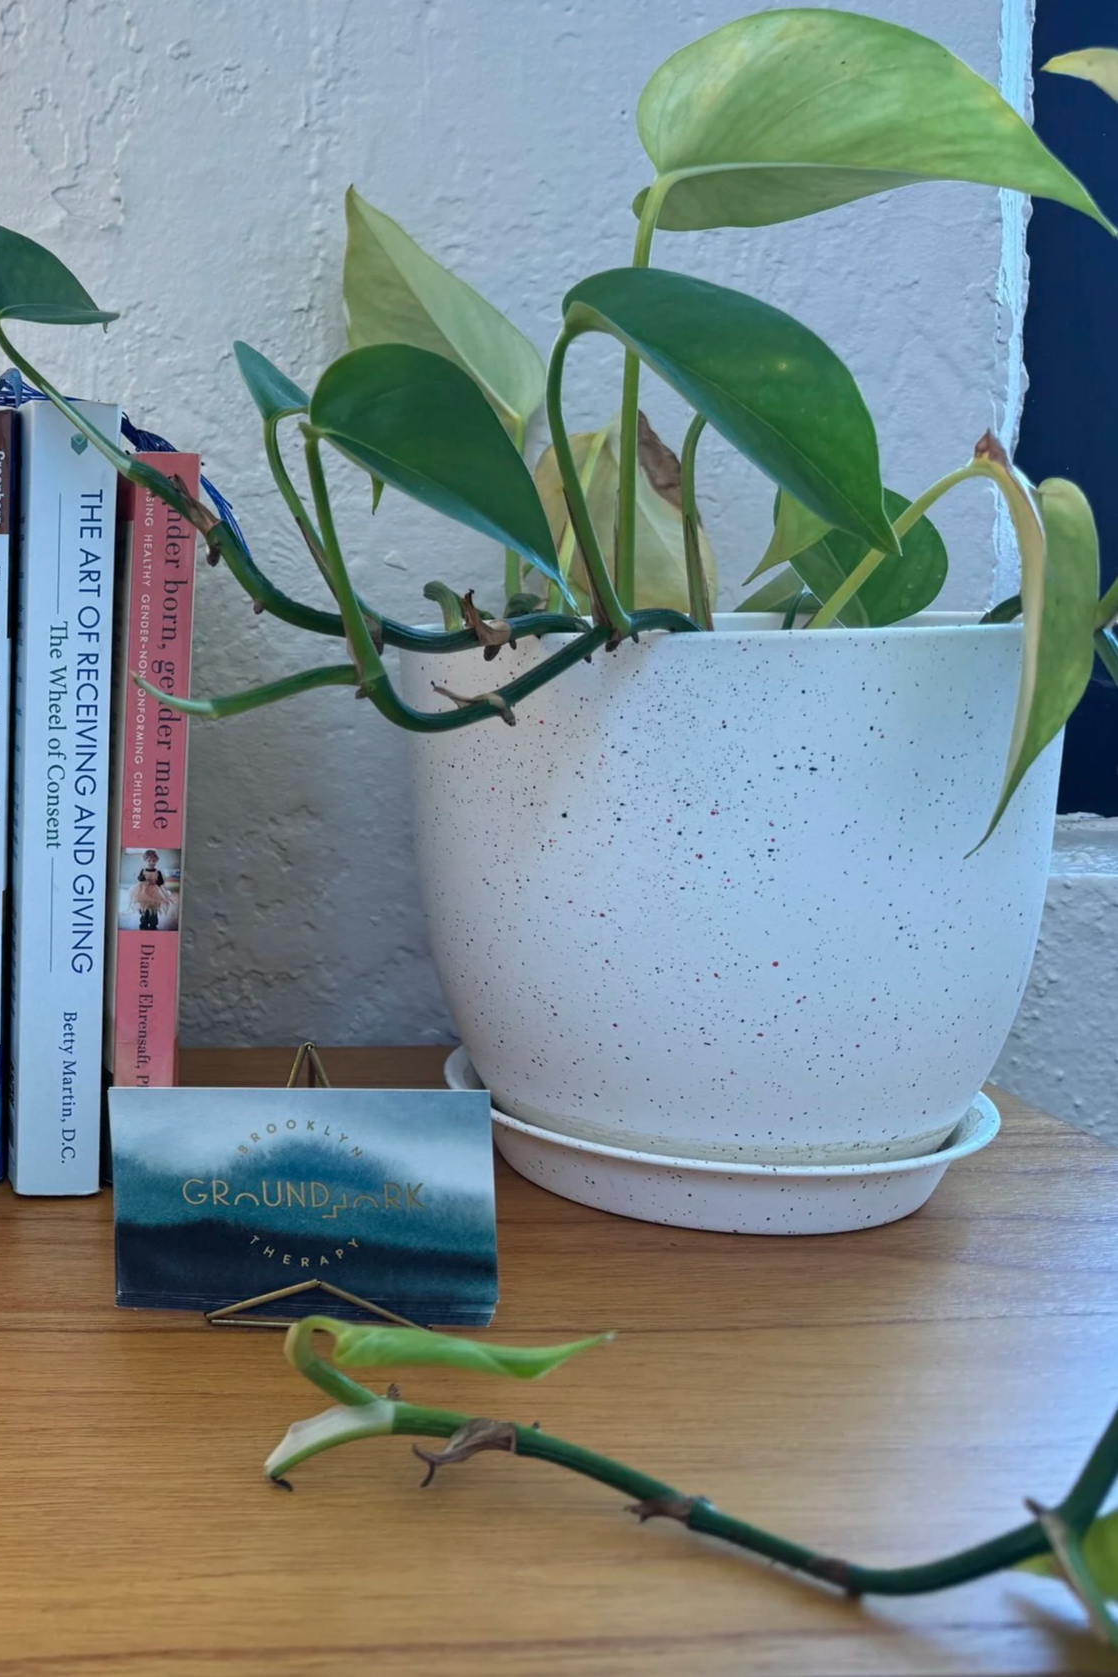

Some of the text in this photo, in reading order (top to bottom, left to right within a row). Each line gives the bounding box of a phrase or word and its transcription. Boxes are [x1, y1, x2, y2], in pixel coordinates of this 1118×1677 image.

[142, 534, 154, 587] HEALTHY
[156, 578, 188, 650] born,
[134, 594, 151, 764] GENDER-NONONFORMING
[46, 620, 68, 849] The Wheel of Consent
[71, 489, 103, 974] THE ART OF RECEIVING AND GIVING
[132, 772, 143, 829] CHILDREN
[153, 759, 178, 830] made
[139, 944, 155, 988] Diane
[134, 994, 154, 1070] Ehrensaft,
[58, 1012, 78, 1164] Betty Martin, D.C.
[238, 1120, 363, 1158] BROOKLYN
[250, 1235, 358, 1268] THERAPY
